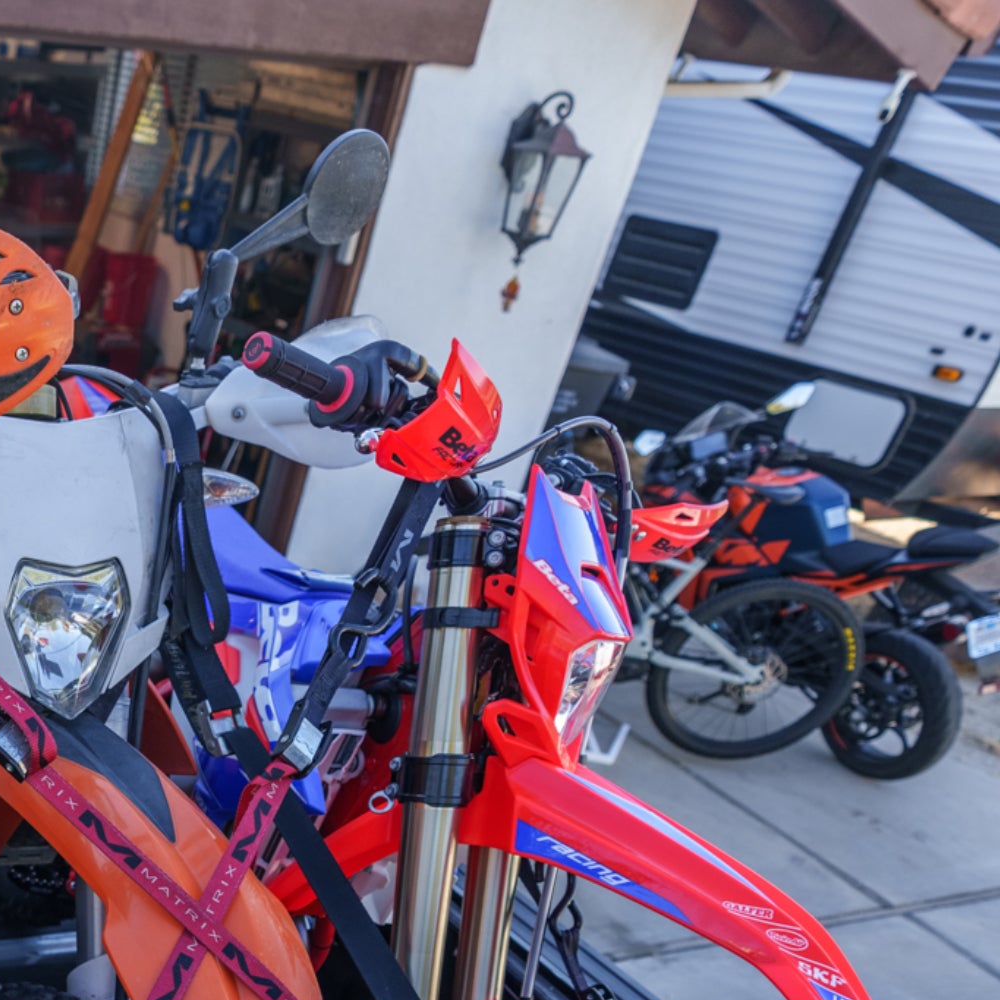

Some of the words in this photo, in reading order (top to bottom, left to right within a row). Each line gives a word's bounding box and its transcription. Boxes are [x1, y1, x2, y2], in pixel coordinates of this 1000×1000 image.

[532, 558, 579, 606] Beta
[536, 836, 631, 886] racing
[141, 867, 223, 944] MATRIX
[798, 960, 847, 988] SKF
